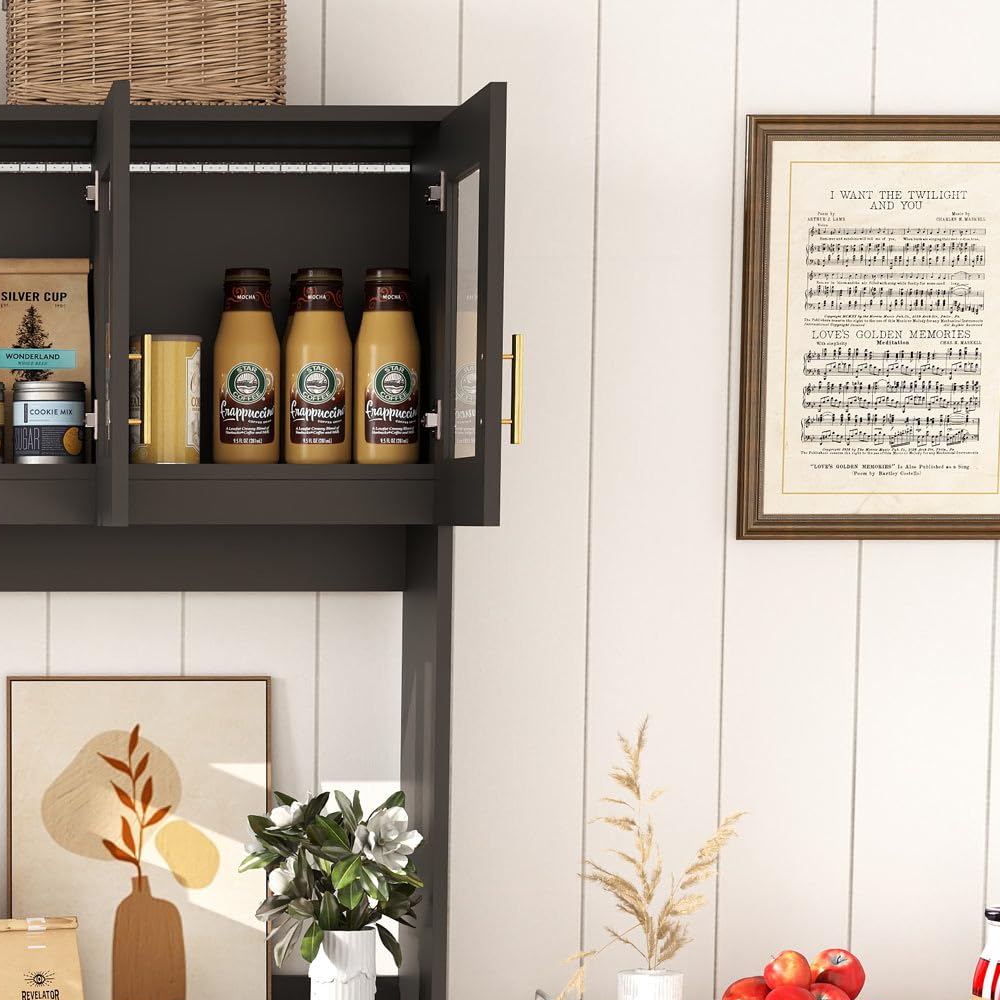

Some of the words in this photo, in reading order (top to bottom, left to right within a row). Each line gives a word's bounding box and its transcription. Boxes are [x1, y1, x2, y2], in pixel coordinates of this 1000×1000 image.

[830, 191, 834, 199] I
[840, 191, 874, 199] WANT
[879, 191, 902, 199] THE
[908, 191, 968, 199] TWILIGHT
[870, 202, 895, 210] AND
[900, 202, 923, 210] YOU
[1, 292, 40, 302] SILVER
[44, 292, 67, 302] CUP
[812, 330, 850, 339] LOVE'S
[856, 330, 902, 339] GOLDEN
[910, 330, 971, 339] MEMORIES
[236, 365, 258, 373] STAR
[306, 365, 328, 373] STAR
[384, 365, 406, 373] STAR
[233, 392, 261, 402] COFFEE
[303, 392, 331, 402] COFFEE
[381, 392, 409, 402] COFFEE
